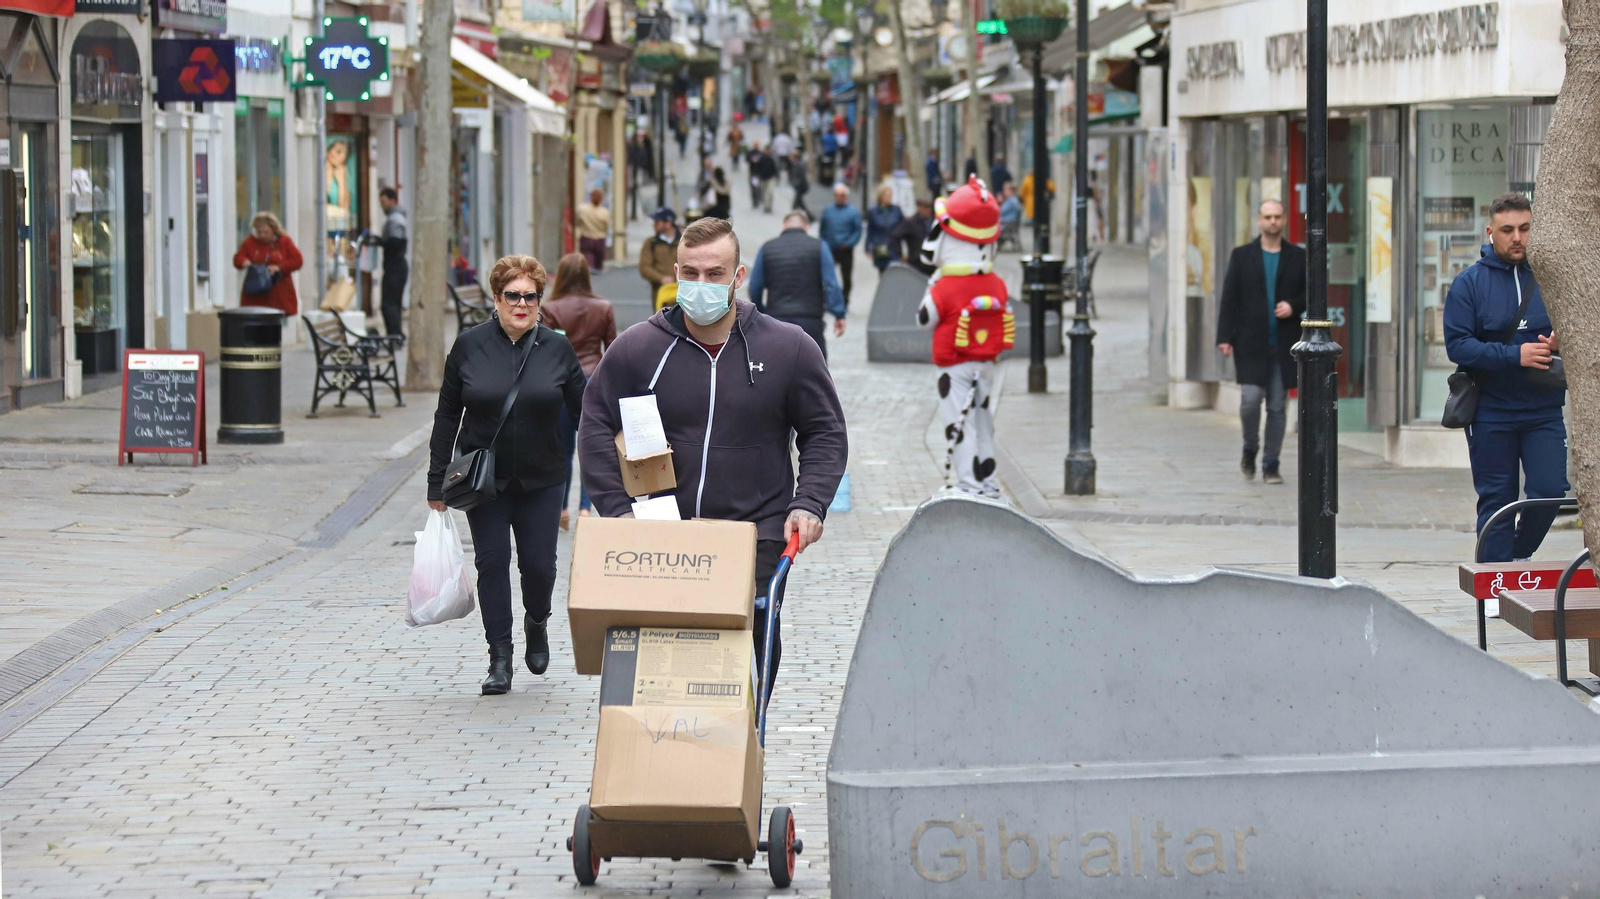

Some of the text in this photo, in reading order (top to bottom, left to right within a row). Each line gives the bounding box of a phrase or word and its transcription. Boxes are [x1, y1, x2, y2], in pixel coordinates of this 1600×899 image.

[1294, 183, 1344, 214] TX
[603, 565, 712, 575] HEALTHCARE
[612, 630, 637, 640] S/6.5
[648, 631, 675, 639] Polyco
[641, 713, 710, 745] VAL
[909, 813, 1260, 883] Gibraltar
